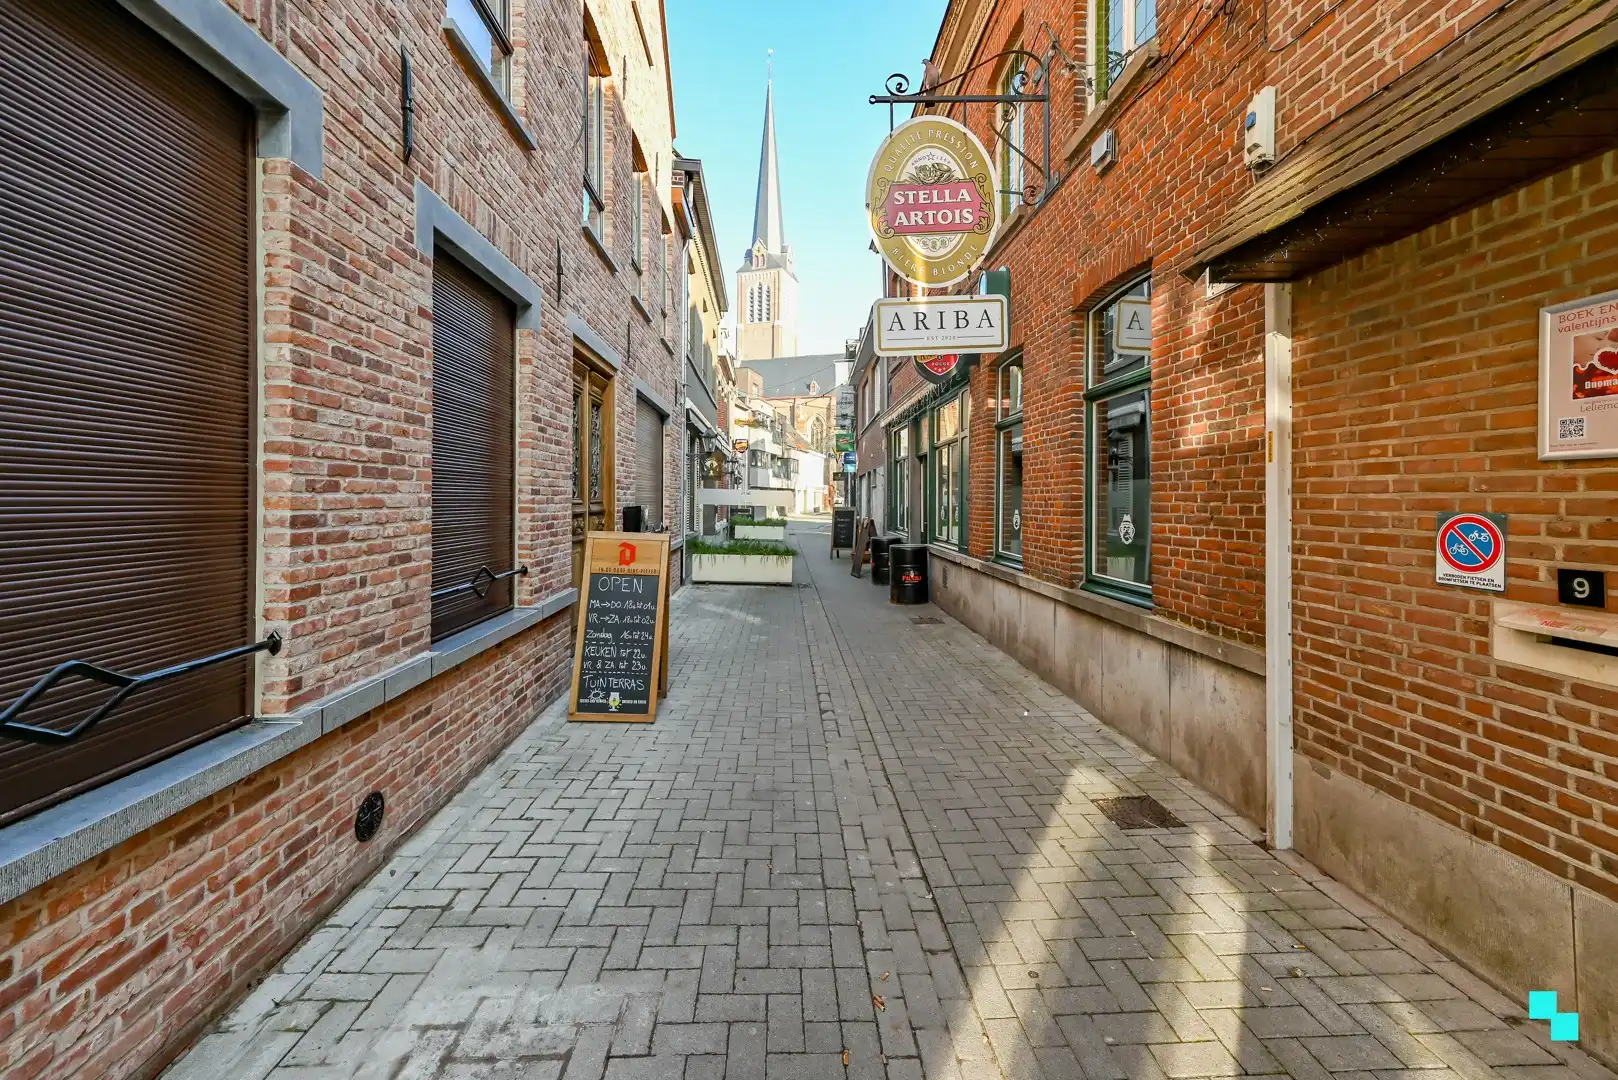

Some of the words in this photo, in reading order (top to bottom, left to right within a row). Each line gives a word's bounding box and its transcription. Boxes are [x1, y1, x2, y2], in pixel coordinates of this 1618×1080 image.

[928, 129, 979, 169] PRESSION
[893, 187, 973, 206] STELLA
[894, 208, 974, 228] ARTOIS
[931, 244, 979, 276] BLONDE
[886, 307, 996, 333] ARIBA
[1557, 315, 1618, 334] valentijns
[1558, 307, 1595, 324] BOEK
[597, 576, 644, 594] OPEN
[1438, 576, 1469, 584] BROMFIETSEN
[1476, 581, 1502, 589] PLAATSEN
[1443, 572, 1466, 580] VERBODEN
[1573, 577, 1590, 599] 9
[586, 627, 613, 645] Zondag
[584, 645, 617, 658] KEUKEN
